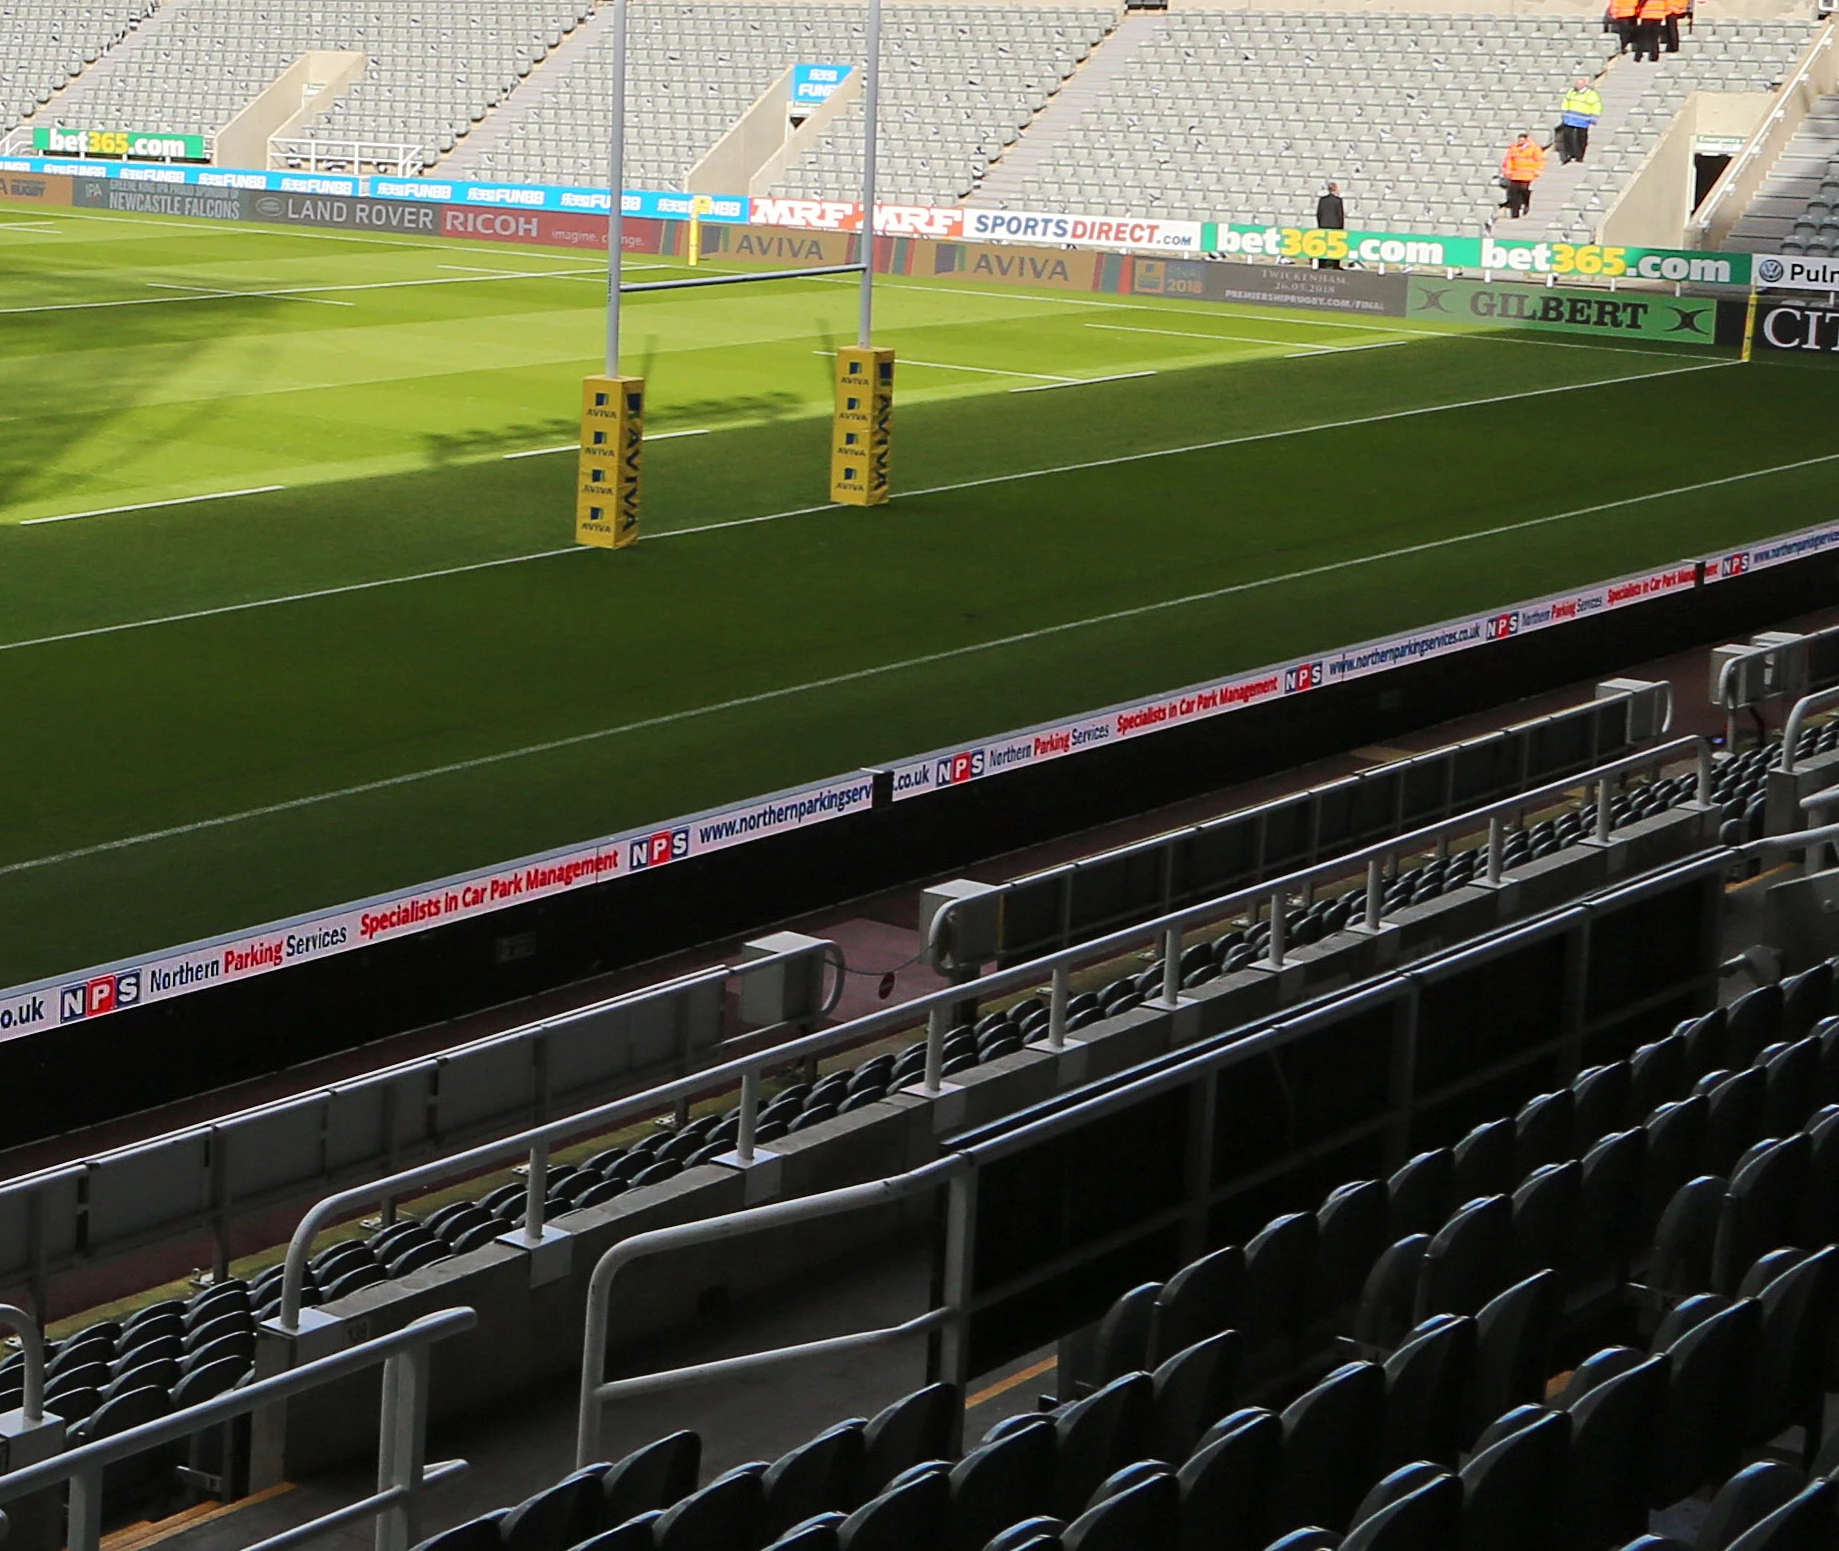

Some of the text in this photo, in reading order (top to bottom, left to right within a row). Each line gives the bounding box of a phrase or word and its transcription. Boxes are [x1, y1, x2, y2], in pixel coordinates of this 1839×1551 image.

[50, 129, 185, 157] bet365.com
[109, 191, 240, 220] NEWCASTLE FALCONS
[287, 198, 434, 229] LAND ROVER
[753, 197, 853, 229] MRF
[444, 210, 540, 237] RICOH
[974, 213, 1192, 247] SPORTSDIRECT.COM
[735, 234, 823, 260] AVIVA
[1217, 222, 1443, 264] bet365.com
[974, 253, 1069, 282] AVIVA
[1481, 237, 1731, 283] bet365.com
[1469, 290, 1649, 330] GILBERT
[623, 427, 641, 532] AVIVA
[1722, 552, 1750, 576] NPS
[1485, 611, 1519, 641] NPS
[1285, 661, 1323, 694] NPS
[936, 676, 1278, 788] NPS Northern Parking Services Specialists in Car Park Management
[630, 765, 930, 869] NPS www.northernparkingserv.co.uk
[61, 849, 619, 1022] NPS Northern Parking Services Specialists in Car Park Management
